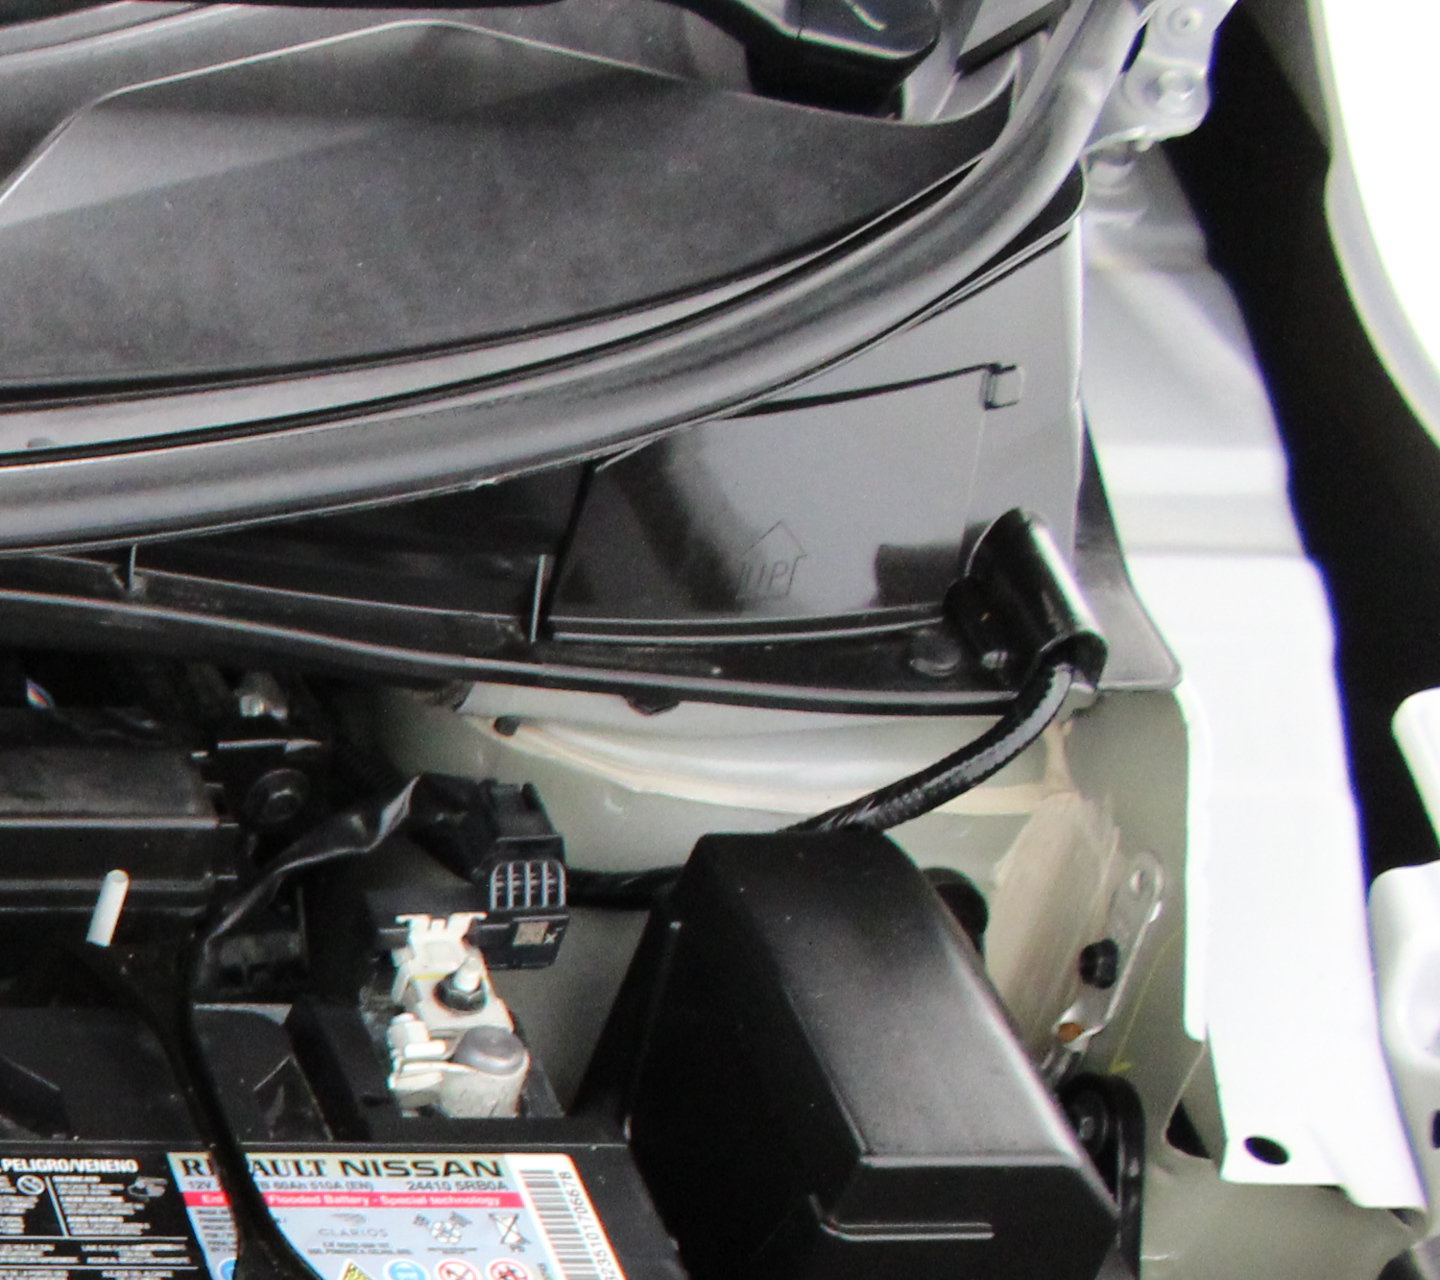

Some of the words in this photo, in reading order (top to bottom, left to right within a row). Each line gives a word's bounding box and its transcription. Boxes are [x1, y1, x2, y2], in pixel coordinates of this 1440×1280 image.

[0, 1158, 140, 1173] PELIGRO/VENENO
[338, 1159, 504, 1179] NISSAN
[323, 1194, 369, 1207] Battery
[381, 1195, 427, 1207] Special
[429, 1195, 502, 1208] technology
[317, 1228, 389, 1238] CLARIOS
